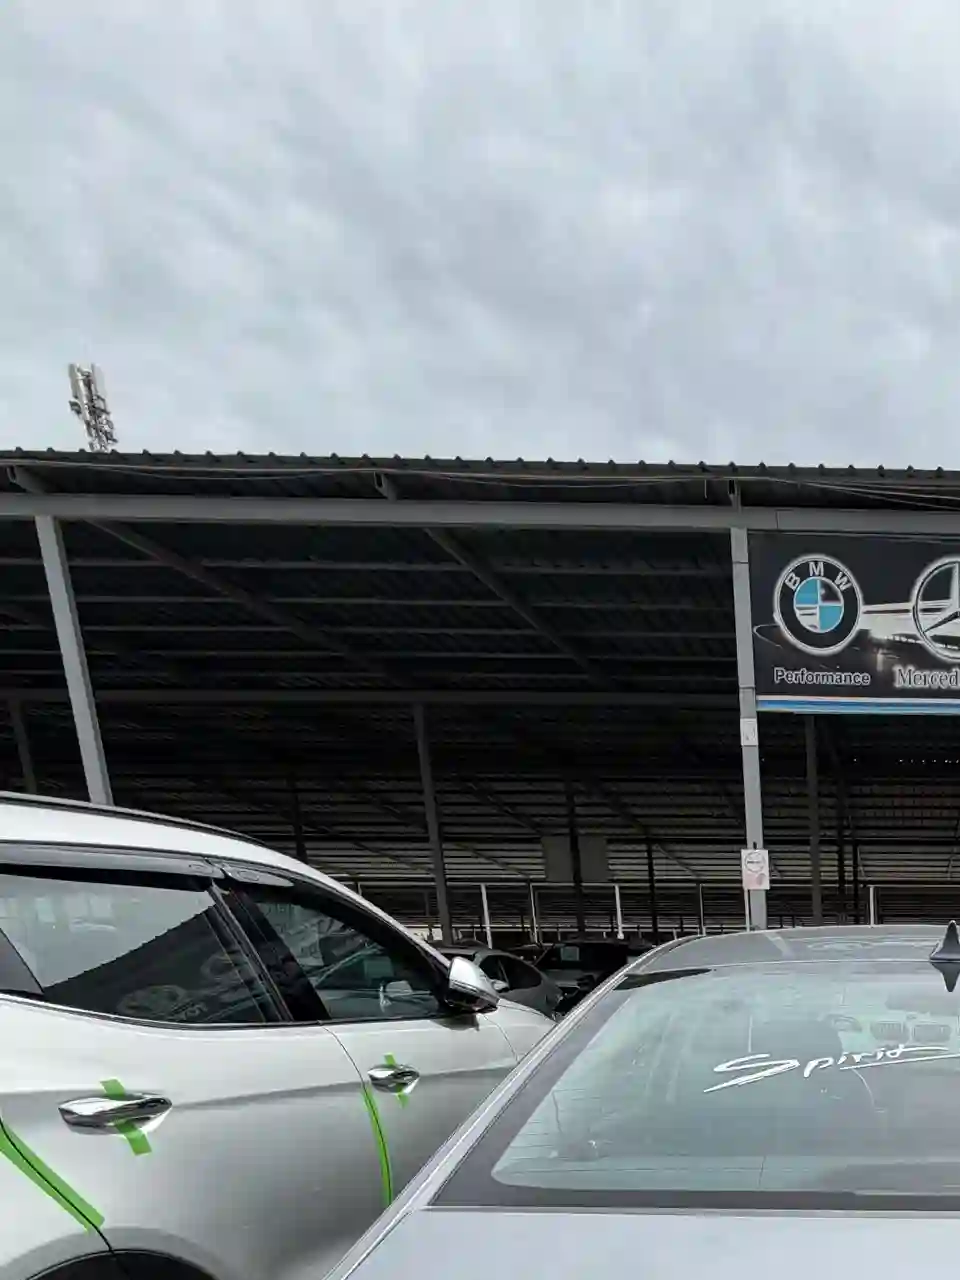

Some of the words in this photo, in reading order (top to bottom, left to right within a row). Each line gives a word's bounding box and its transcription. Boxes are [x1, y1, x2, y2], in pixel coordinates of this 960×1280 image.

[784, 562, 853, 591] BMW
[773, 667, 871, 685] Performance
[703, 1043, 949, 1093] Spirit
